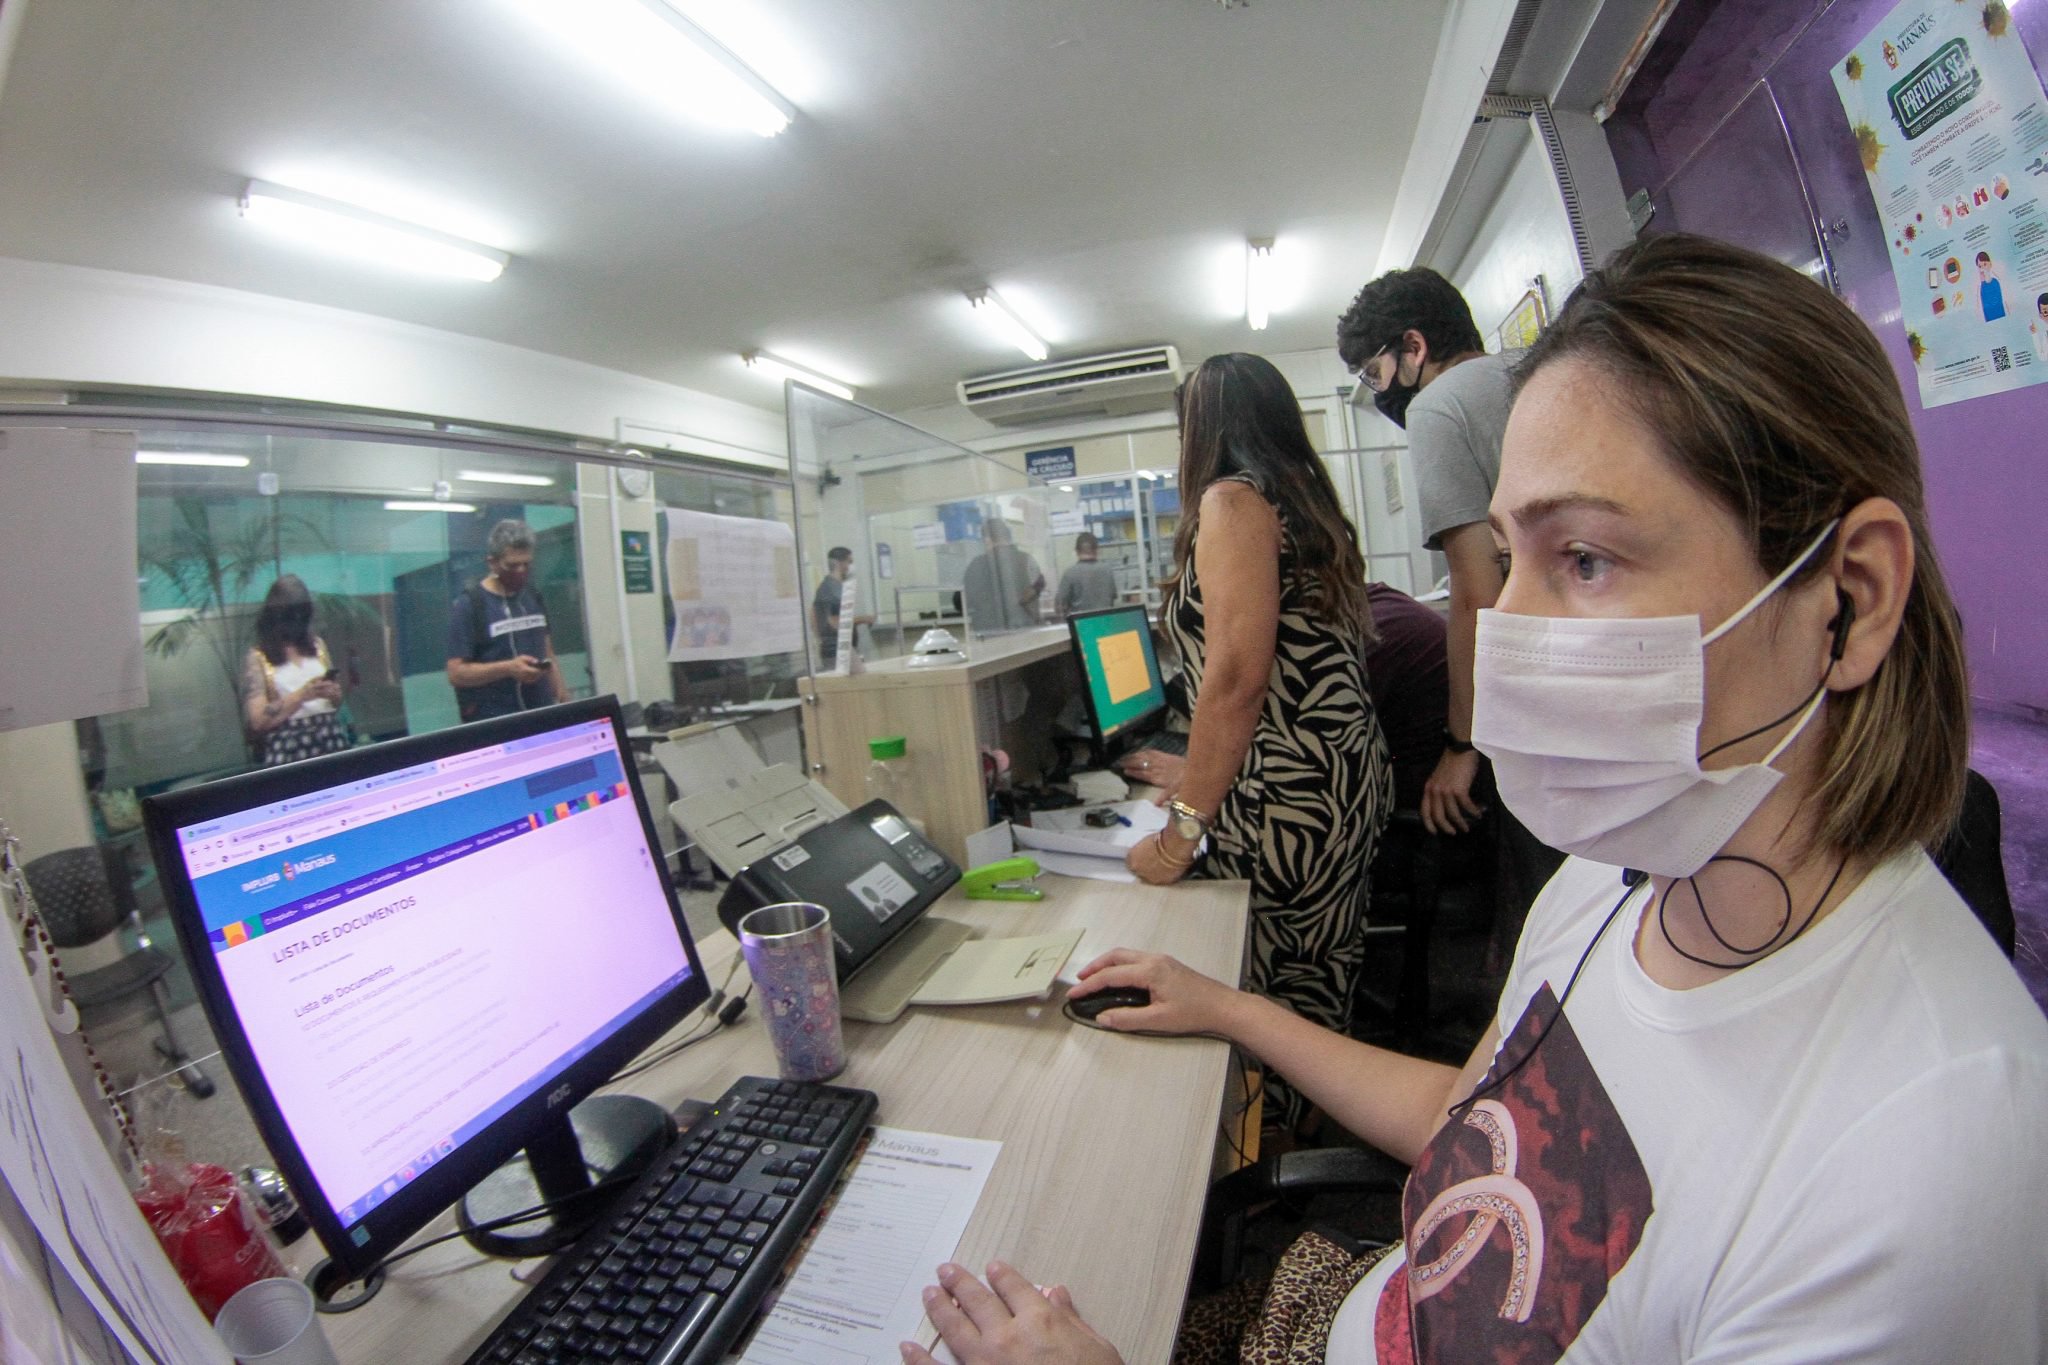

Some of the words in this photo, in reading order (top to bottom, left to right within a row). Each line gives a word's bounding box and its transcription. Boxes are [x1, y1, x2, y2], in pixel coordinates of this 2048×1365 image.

[1897, 14, 1936, 55] MANAUS
[1901, 53, 1966, 118] PREVINA-SE
[1922, 105, 1945, 127] CUIDADO
[1948, 97, 1957, 108] DE
[1939, 130, 1961, 147] COMBATE
[1944, 122, 1959, 135] NOVO
[293, 854, 337, 875] Manaus
[241, 872, 280, 893] IMPLURB
[272, 939, 311, 964] LISTA
[312, 930, 331, 948] DE
[332, 896, 417, 939] DOCUMENTOS
[294, 1000, 320, 1018] Lista
[321, 993, 335, 1005] de
[335, 965, 395, 998] Documentos
[547, 1083, 572, 1110] AOC
[878, 1139, 940, 1156] Manaus
